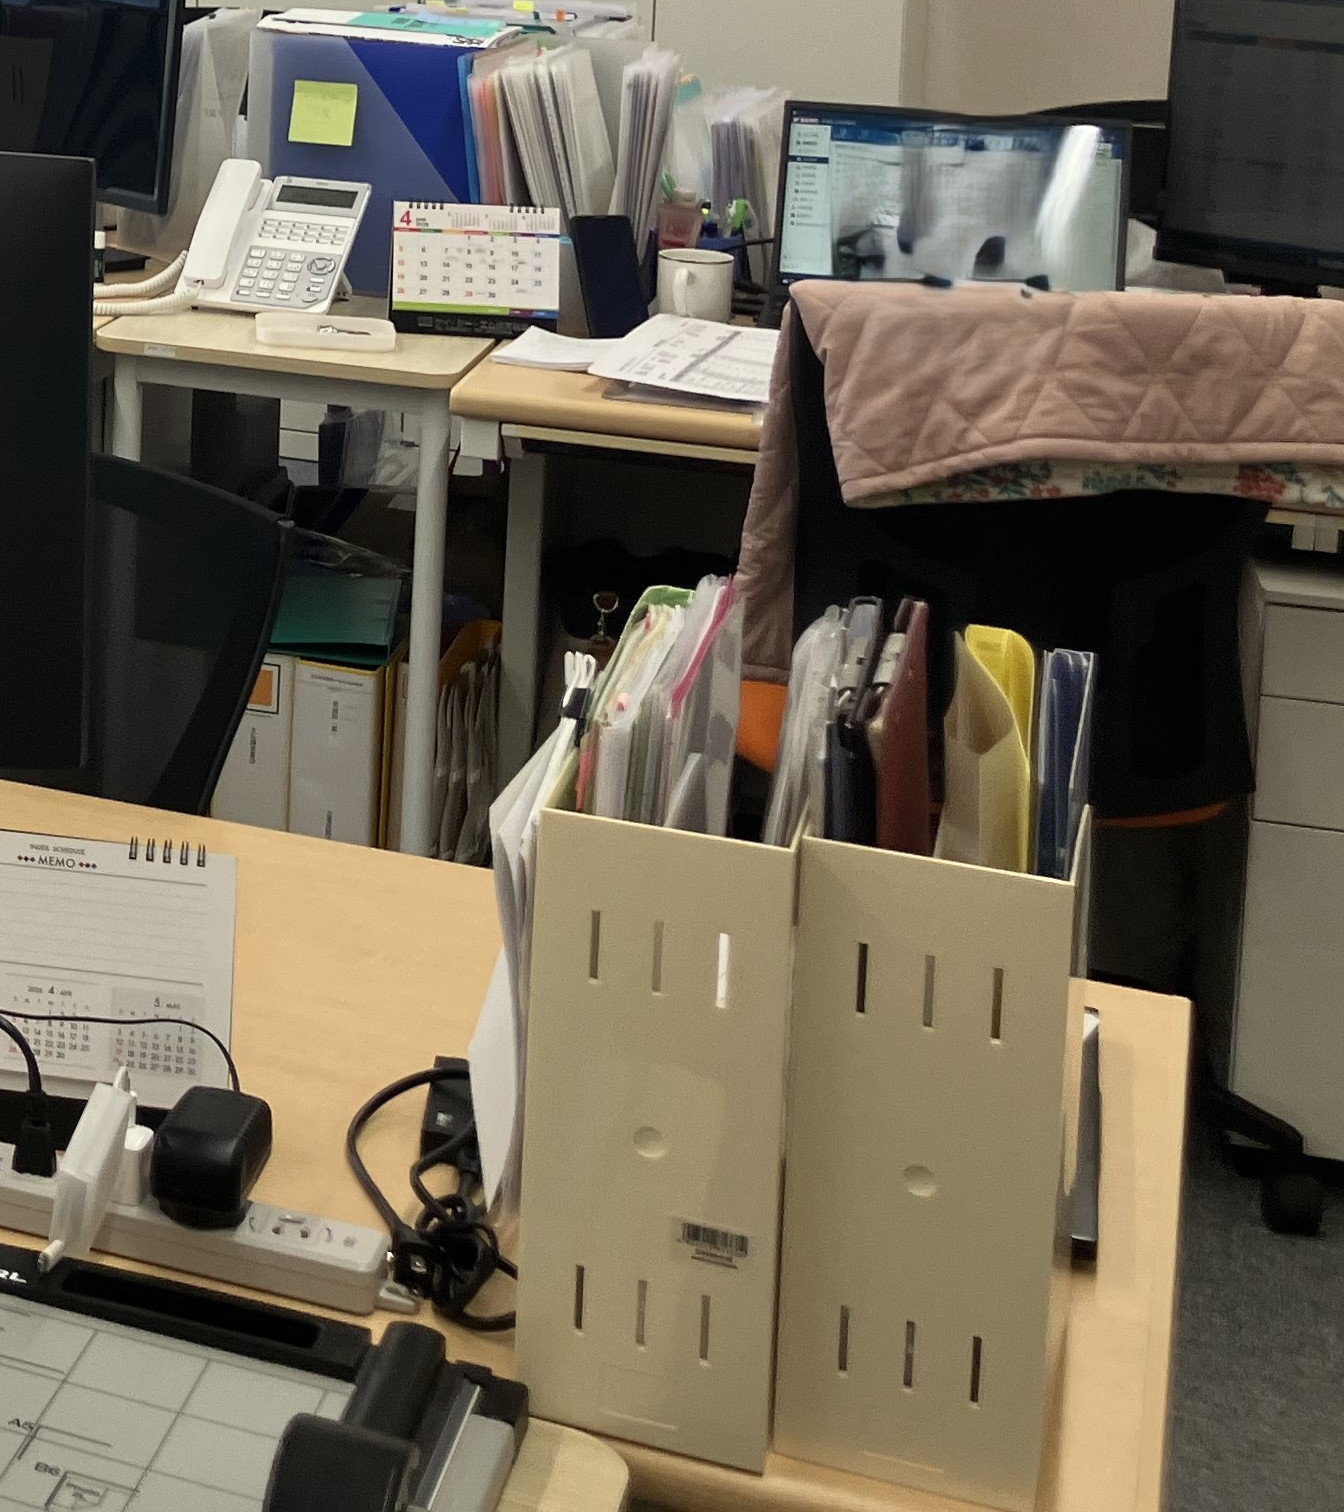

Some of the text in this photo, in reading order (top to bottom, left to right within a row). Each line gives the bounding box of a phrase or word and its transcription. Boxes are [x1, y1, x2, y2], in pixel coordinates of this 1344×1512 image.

[400, 210, 412, 226] 4
[38, 855, 76, 869] MEMO
[48, 986, 54, 994] 4
[8, 1418, 35, 1431] A5
[35, 1462, 60, 1476] B6
